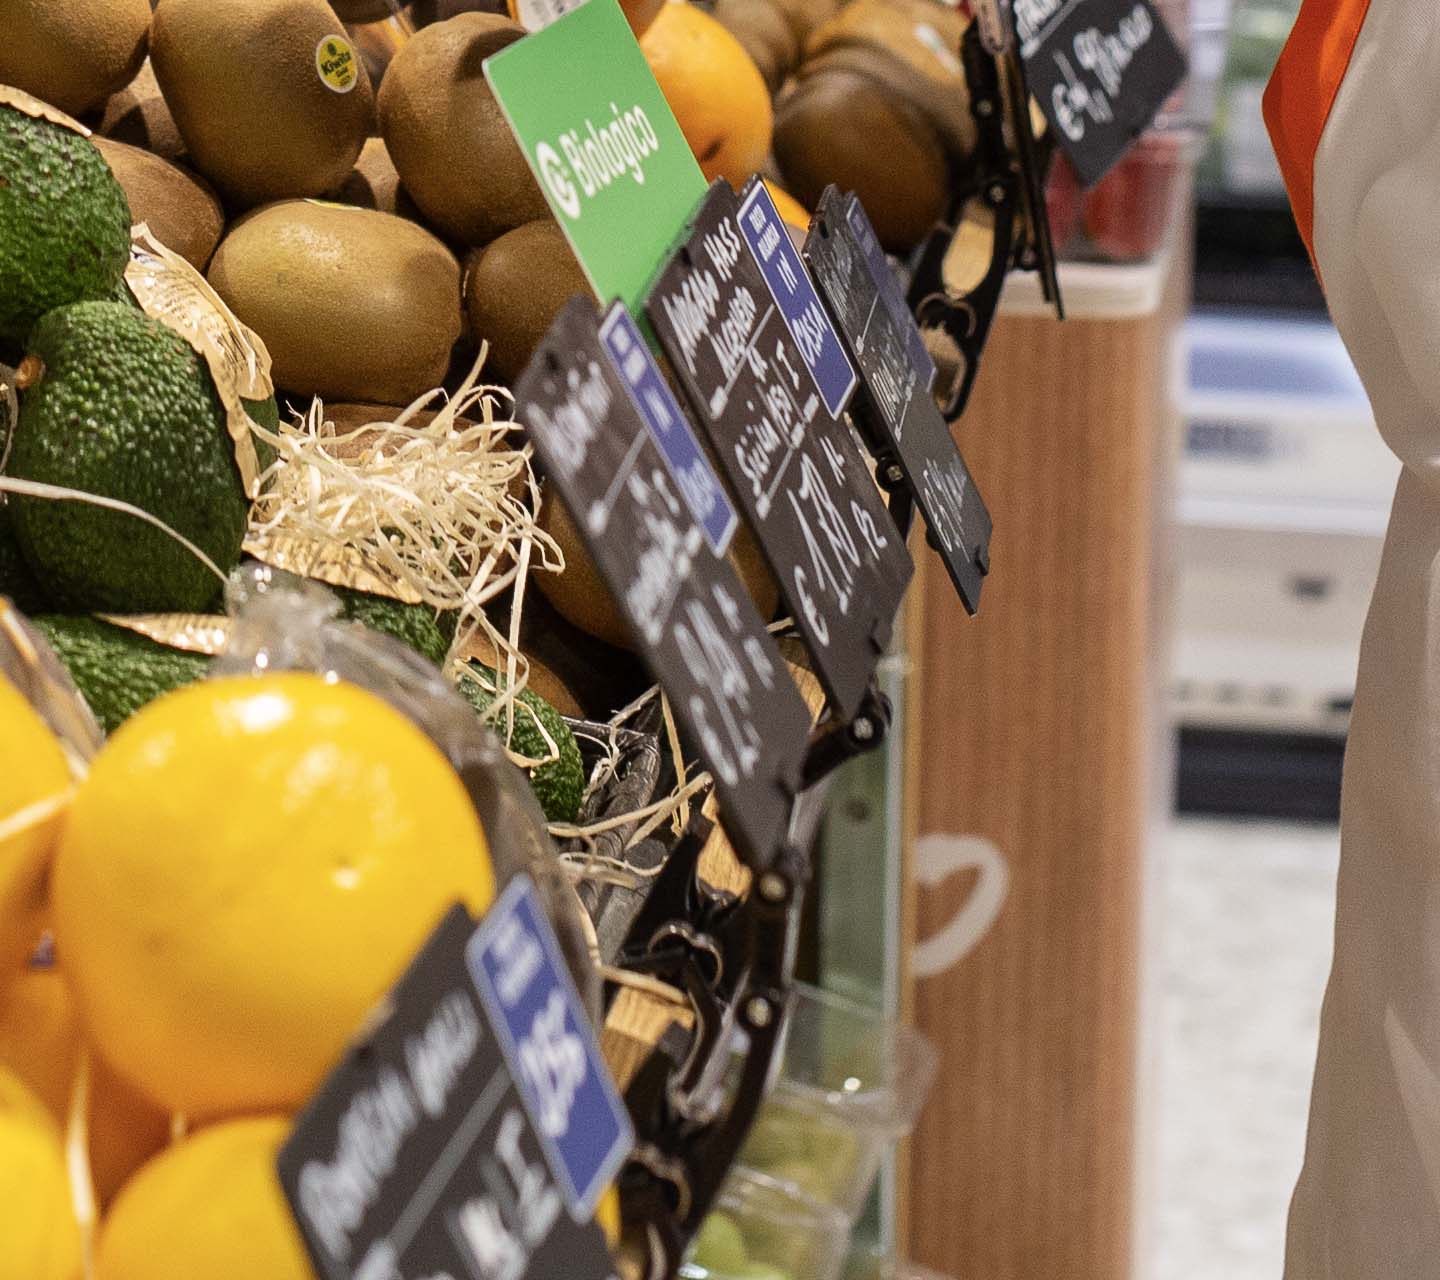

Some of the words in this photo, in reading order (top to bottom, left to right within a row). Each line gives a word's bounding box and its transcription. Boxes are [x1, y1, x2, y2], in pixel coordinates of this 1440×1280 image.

[559, 102, 659, 198] Biologico
[704, 216, 741, 282] HASS
[776, 250, 799, 297] IN
[791, 300, 829, 369] CASSA
[793, 565, 830, 647] €
